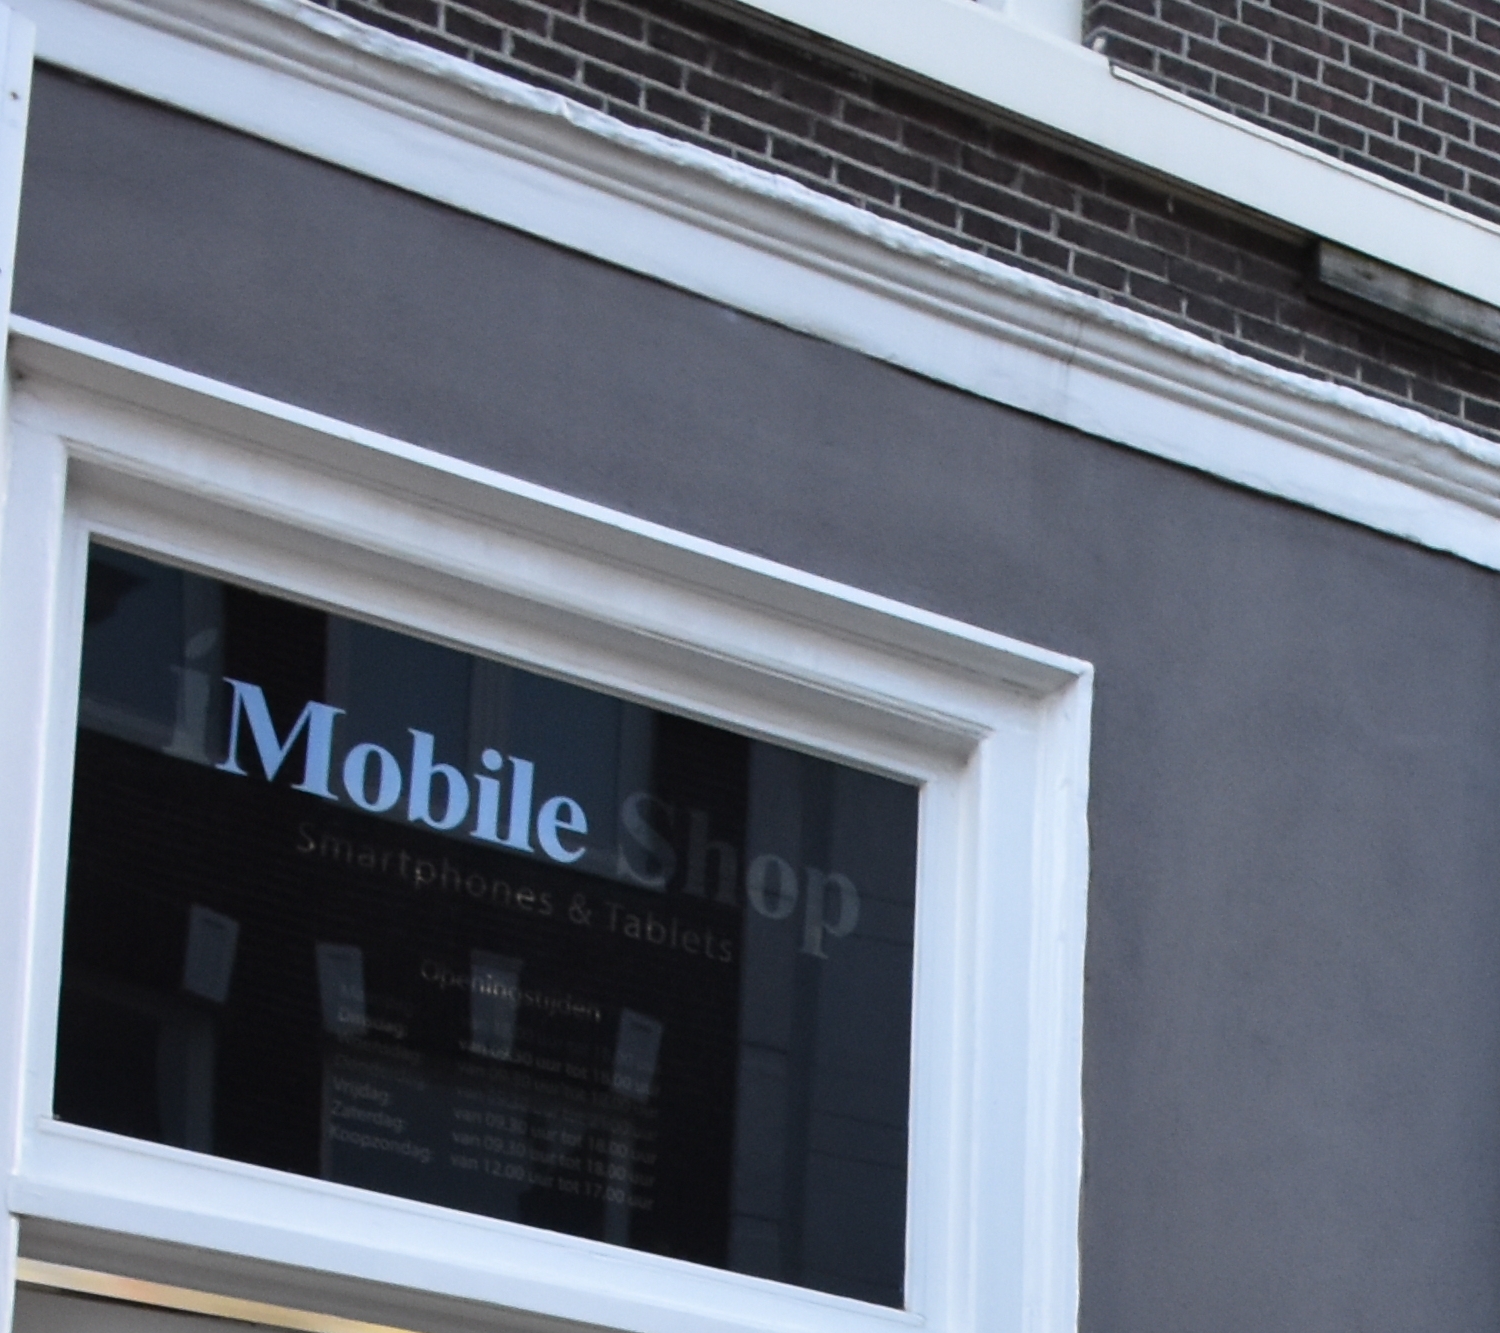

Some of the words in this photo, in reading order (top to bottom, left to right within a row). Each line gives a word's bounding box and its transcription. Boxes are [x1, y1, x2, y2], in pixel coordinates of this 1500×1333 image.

[296, 821, 554, 919] Smartphones
[569, 894, 594, 927] &
[606, 899, 735, 965] Tablets
[620, 791, 862, 962] Shop
